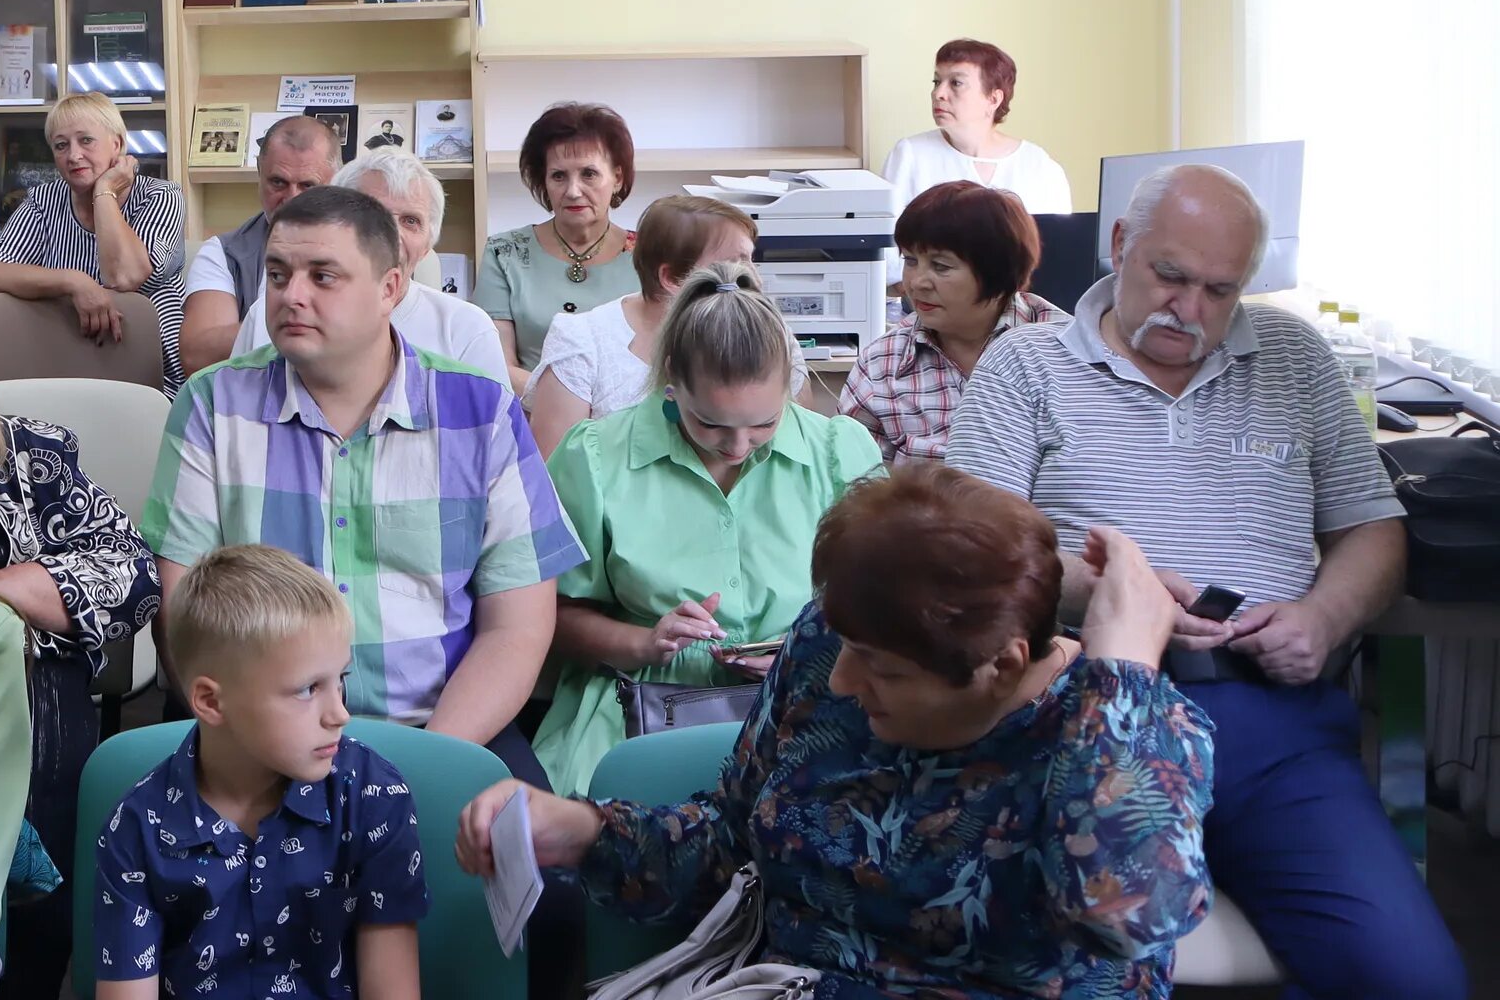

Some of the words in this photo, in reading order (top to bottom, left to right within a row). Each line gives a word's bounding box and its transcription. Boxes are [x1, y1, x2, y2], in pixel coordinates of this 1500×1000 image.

[368, 821, 389, 843] PARTY
[271, 979, 297, 994] HARD!
[275, 974, 289, 985] GO
